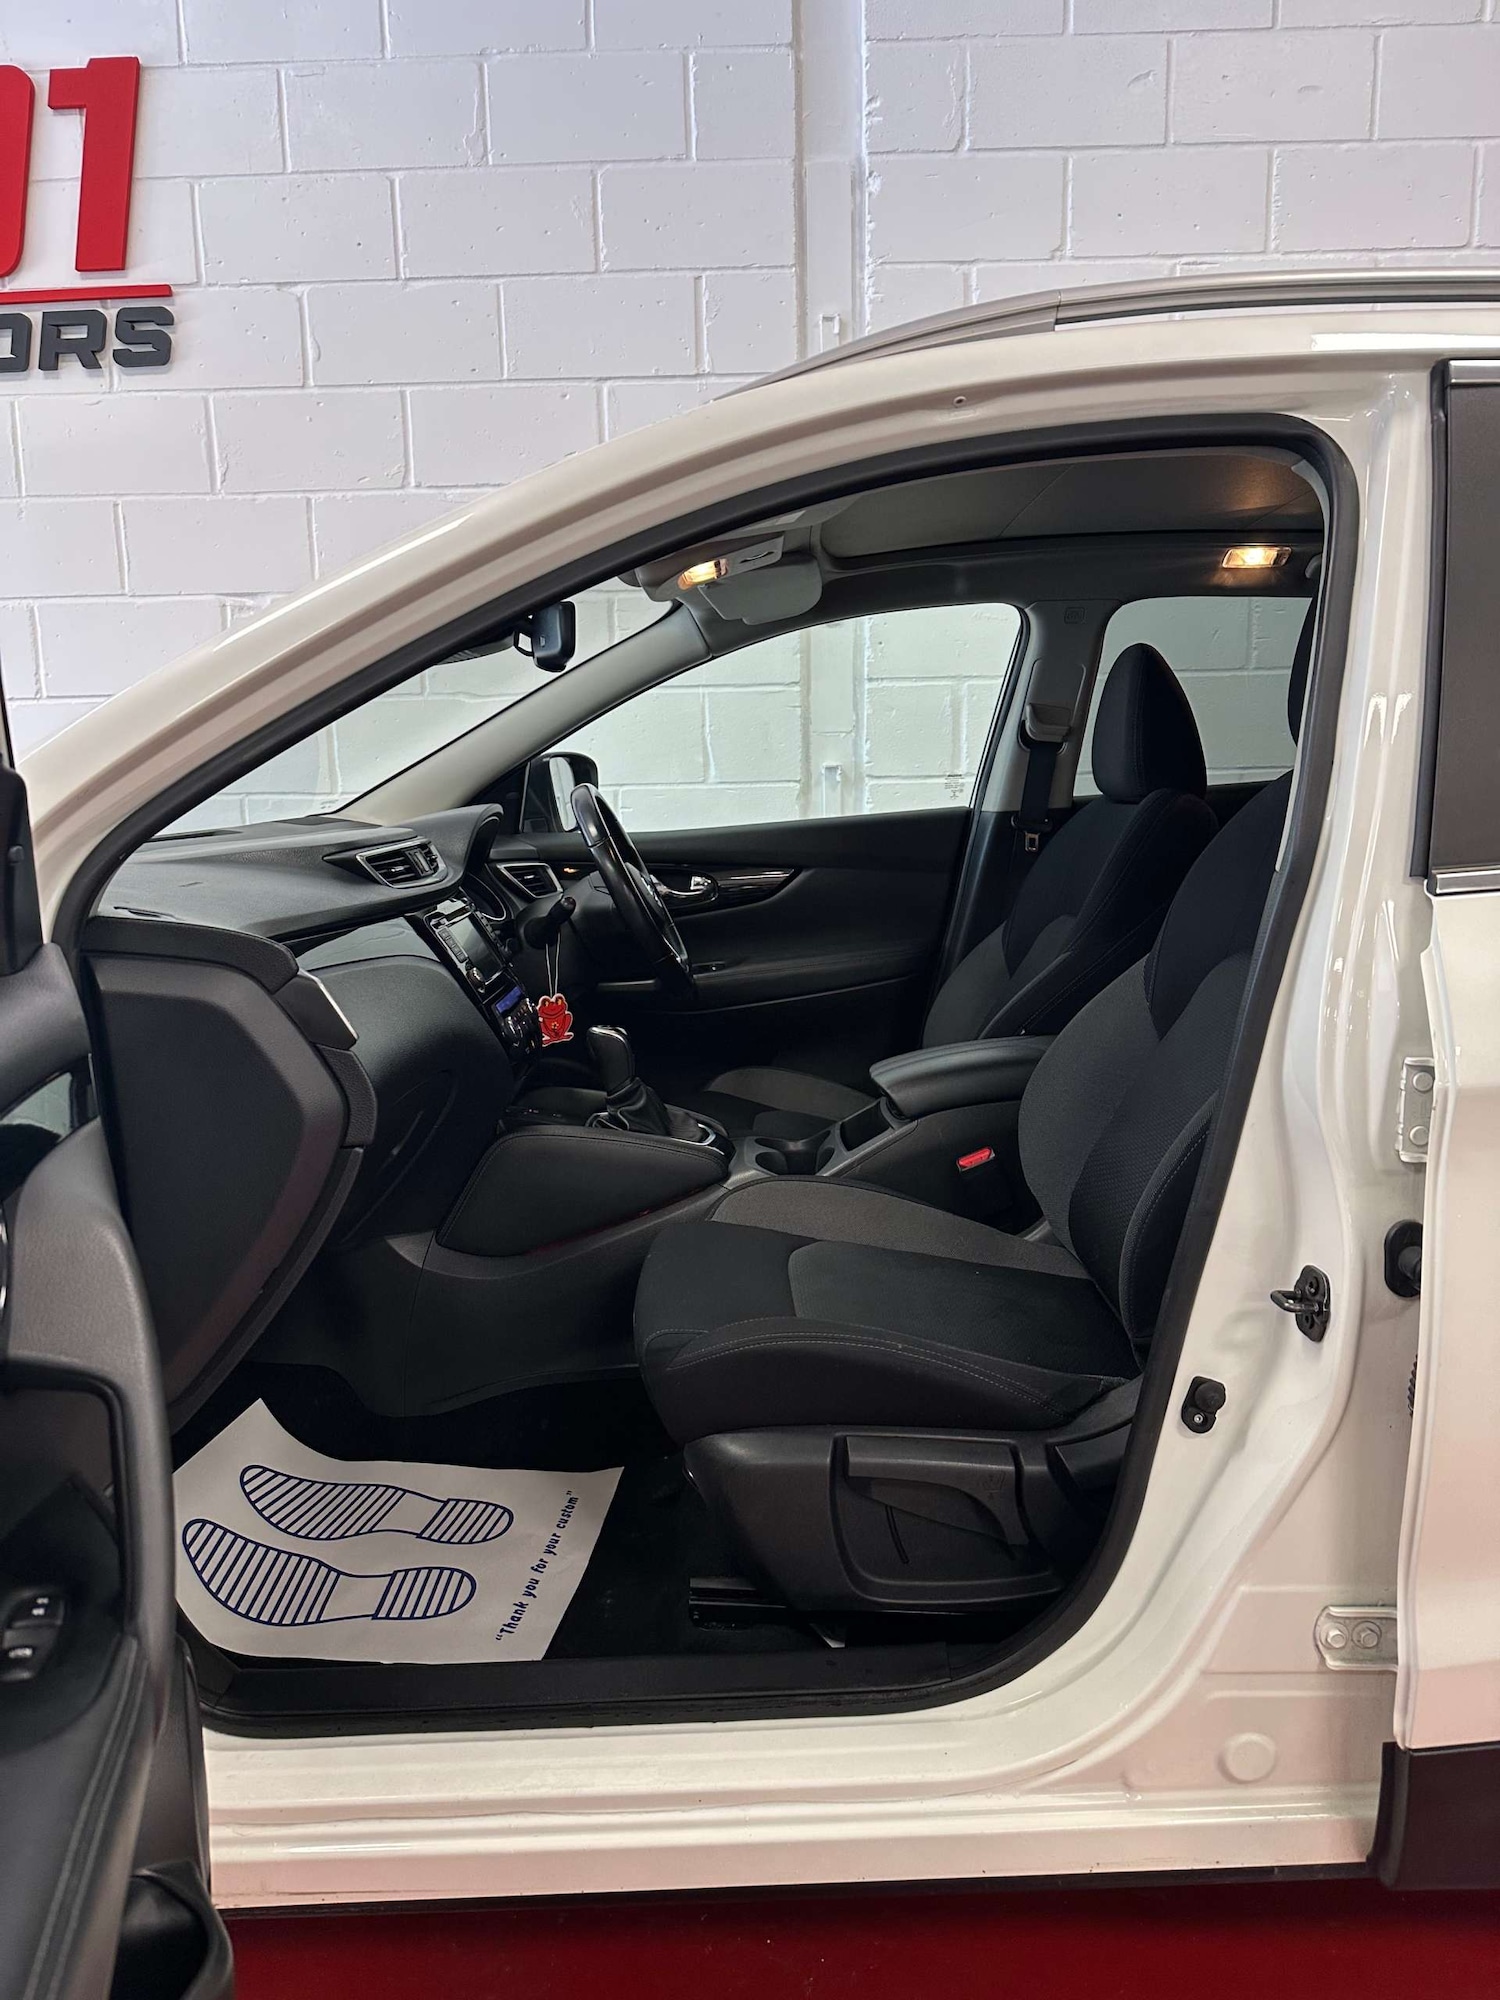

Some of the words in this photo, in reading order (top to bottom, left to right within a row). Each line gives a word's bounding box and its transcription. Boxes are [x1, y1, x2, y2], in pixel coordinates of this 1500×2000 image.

[543, 1532, 561, 1556] your
[530, 1557, 549, 1574] for
[522, 1577, 540, 1599] you
